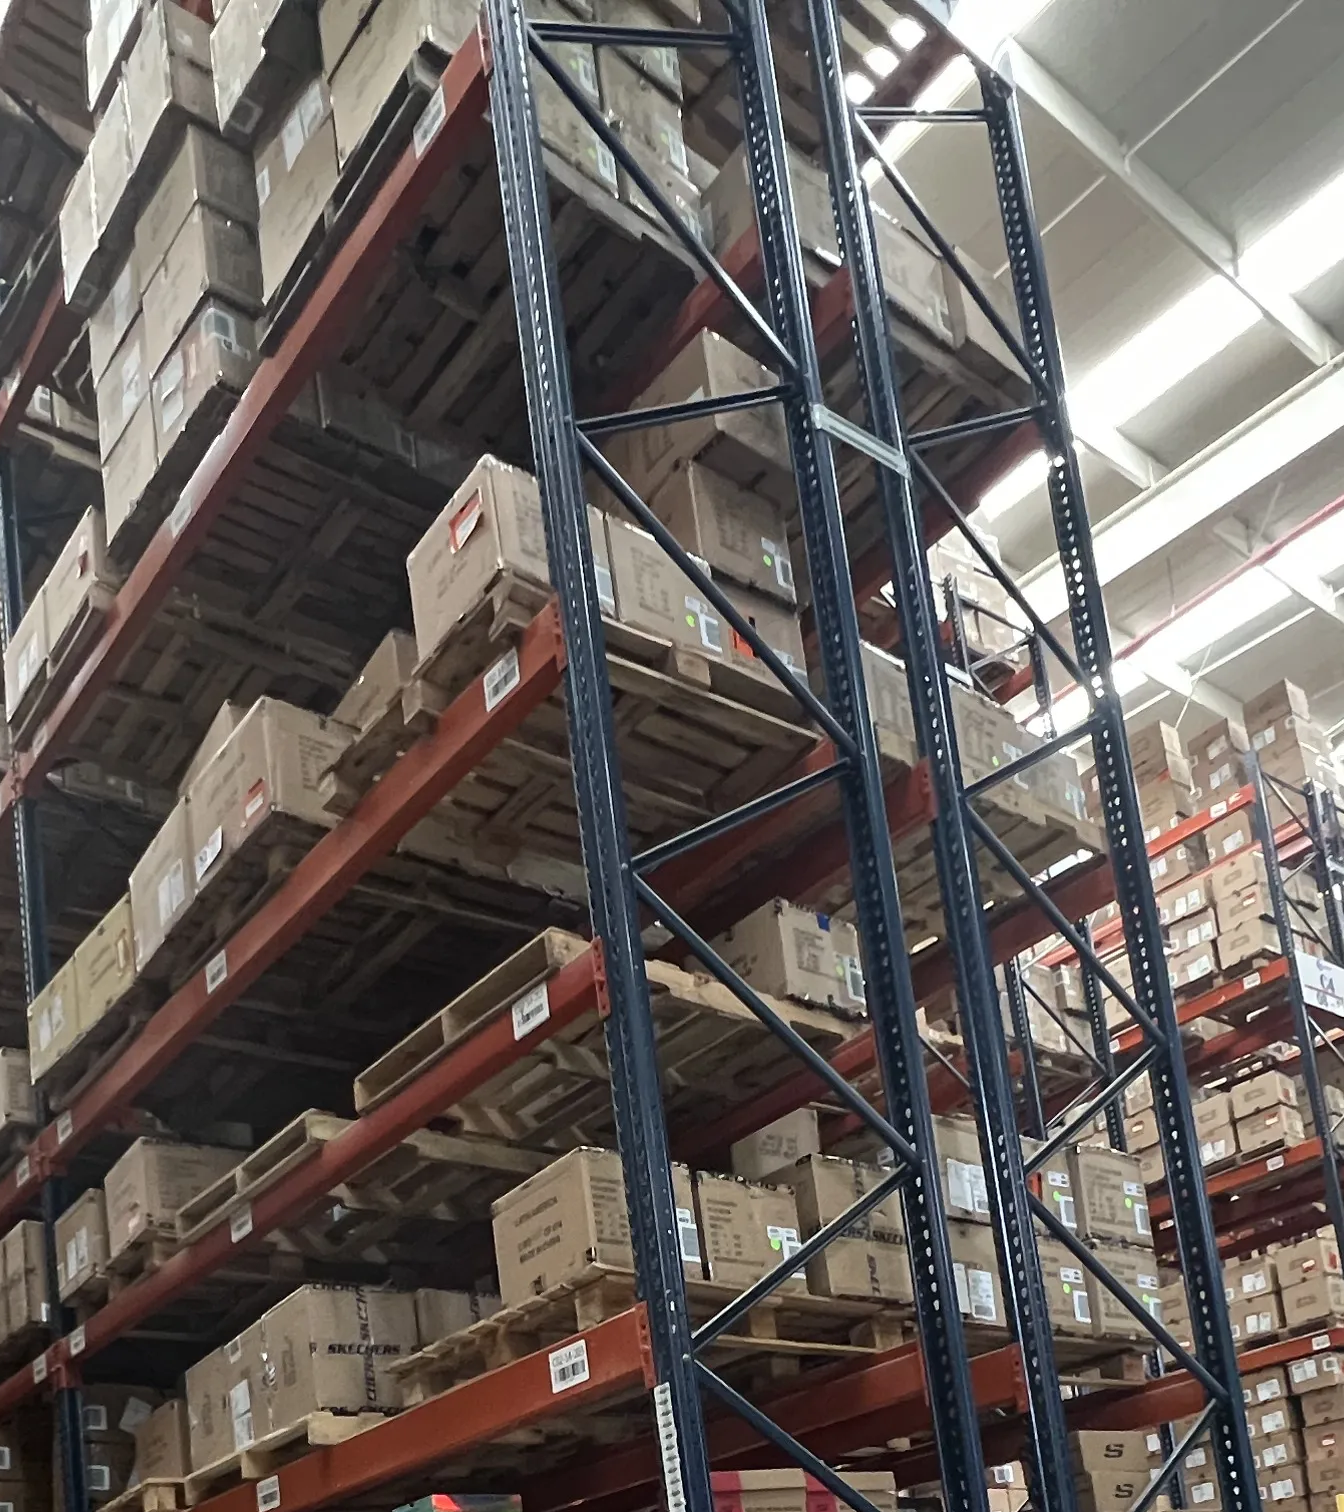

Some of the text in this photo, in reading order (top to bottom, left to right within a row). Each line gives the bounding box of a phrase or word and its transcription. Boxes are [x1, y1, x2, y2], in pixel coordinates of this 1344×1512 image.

[327, 1344, 401, 1355] SKECHERS
[1103, 1443, 1125, 1458] S
[1114, 1483, 1134, 1498] S
